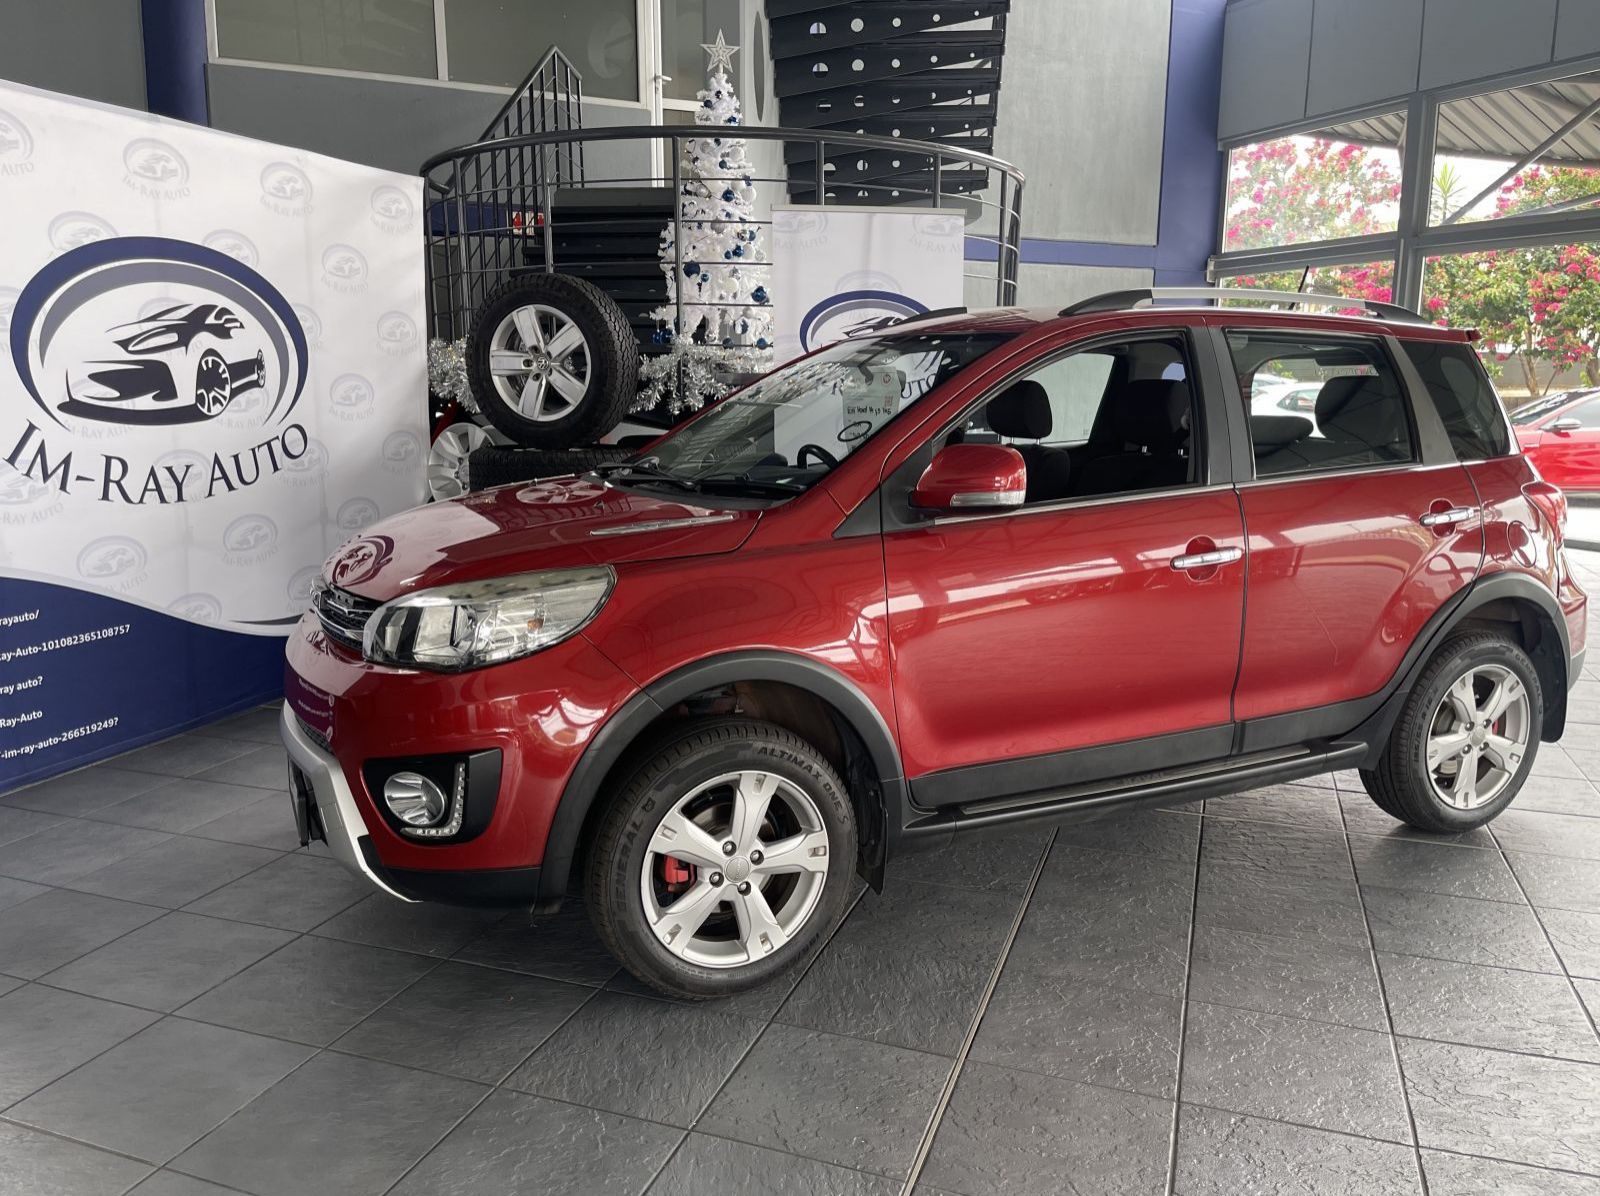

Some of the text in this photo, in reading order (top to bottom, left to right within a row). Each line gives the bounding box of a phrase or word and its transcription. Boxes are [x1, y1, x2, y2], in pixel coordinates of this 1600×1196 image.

[900, 373, 937, 399] UTO
[3, 419, 308, 504] IM-RAY AUTO
[31, 502, 64, 524] AUTO
[0, 624, 130, 662] ay-Auto-101082365108757
[16, 675, 43, 691] auto?
[0, 717, 119, 760] -im-ray-auto-266519249?
[757, 746, 822, 781] ALTIMAX
[823, 783, 843, 813] ONE
[617, 818, 645, 916] GENERAL
